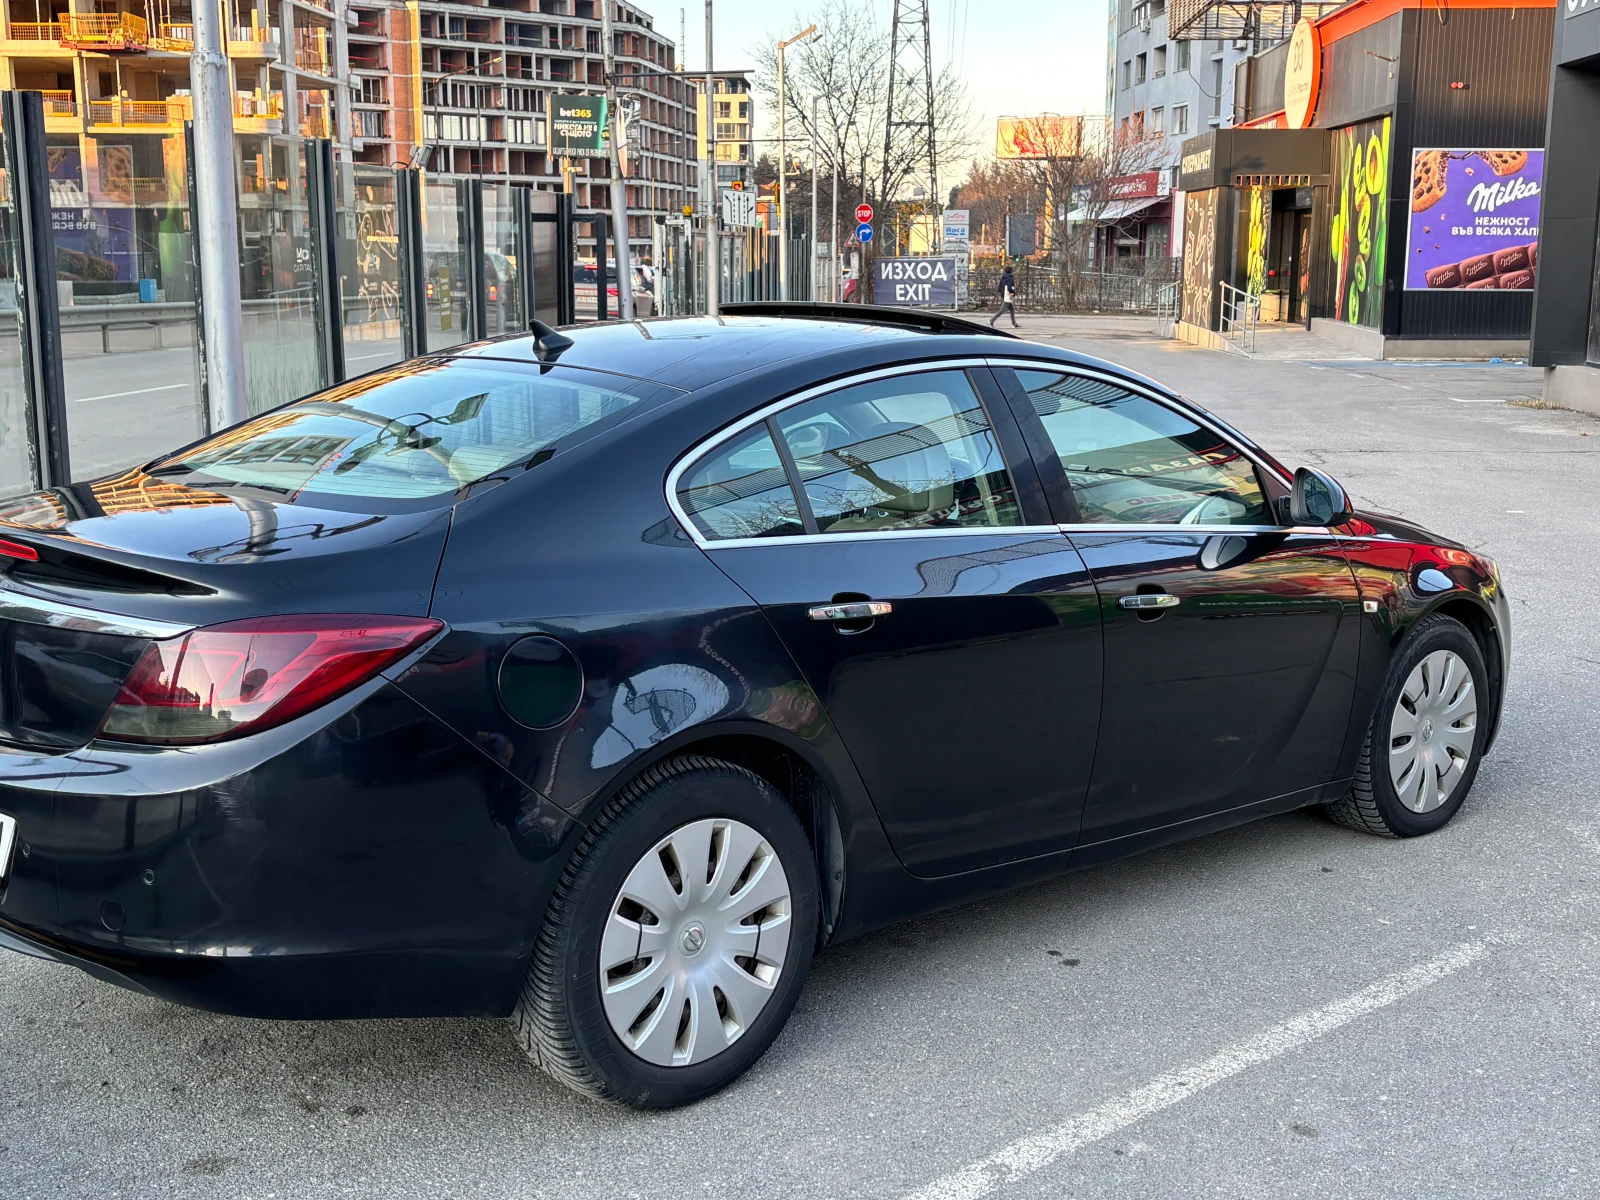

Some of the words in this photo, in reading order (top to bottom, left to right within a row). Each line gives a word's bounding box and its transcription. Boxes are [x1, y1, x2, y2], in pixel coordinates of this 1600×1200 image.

[560, 108, 592, 118] bet365
[1467, 176, 1541, 213] Milka
[857, 209, 872, 218] STOP
[1475, 217, 1530, 226] НЕЖНОСТ
[1452, 227, 1473, 235] ВЪВ
[1476, 227, 1511, 236] ВСЯКА
[881, 262, 947, 281] ИЗХОД
[895, 284, 931, 301] EXIT
